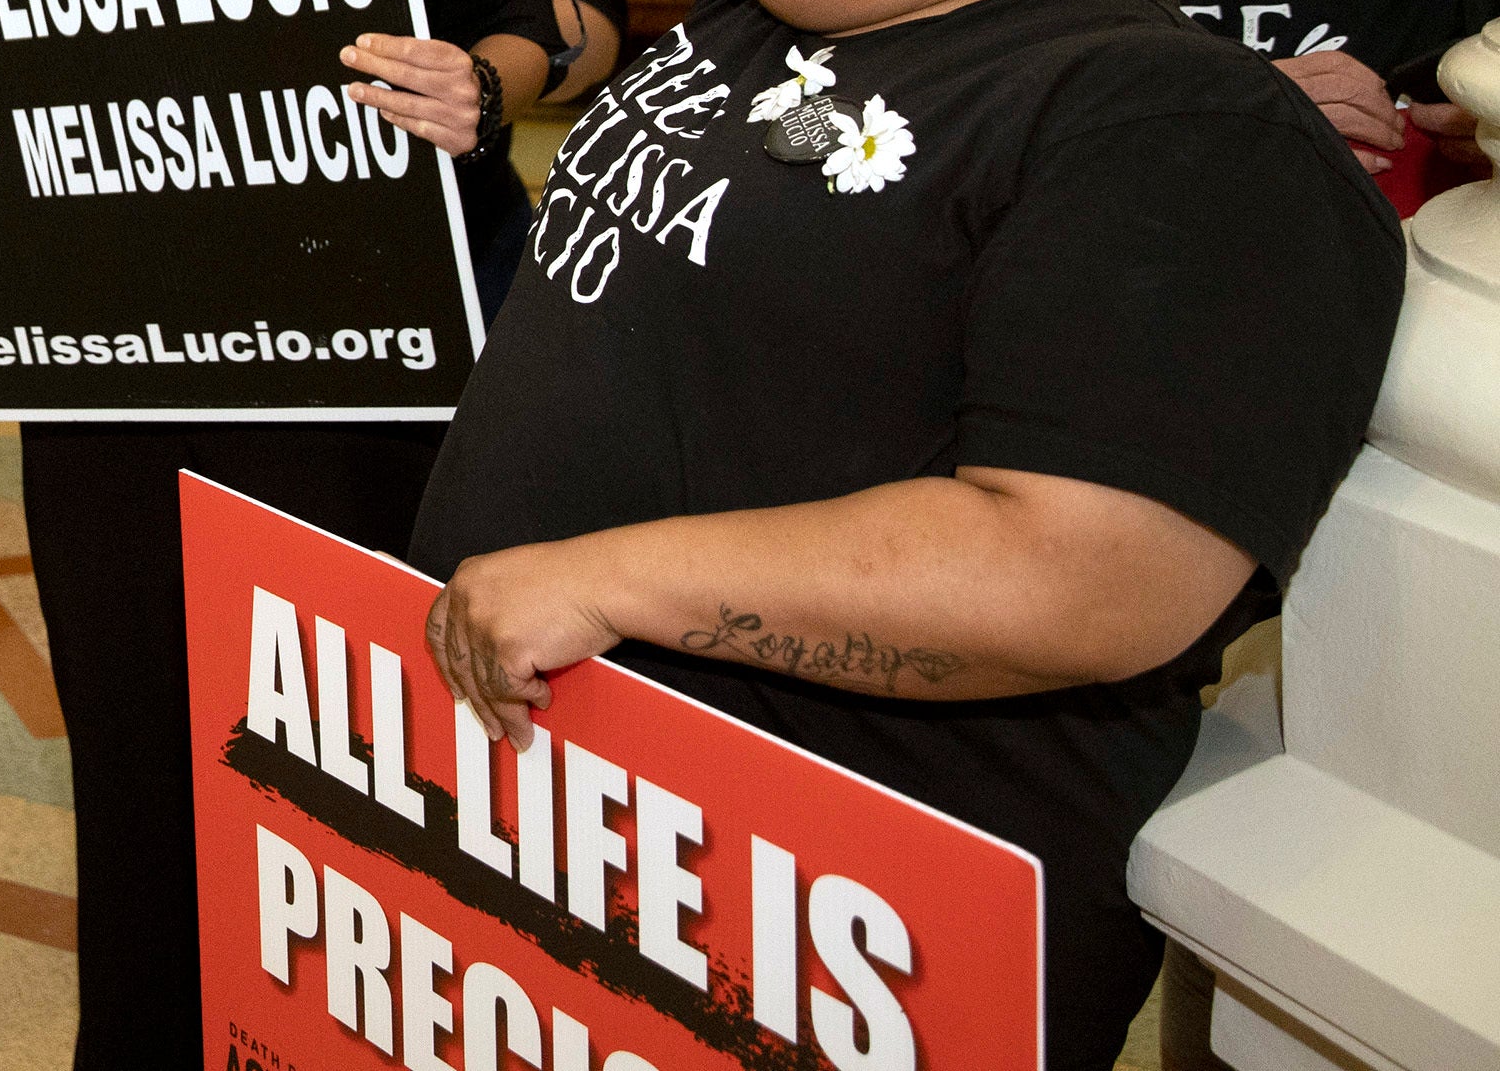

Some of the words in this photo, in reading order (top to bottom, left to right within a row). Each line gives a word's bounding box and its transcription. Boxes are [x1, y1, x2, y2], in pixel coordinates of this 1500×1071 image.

[11, 95, 235, 199] MELISSA
[235, 79, 410, 188] LUCIO
[247, 584, 426, 829] ALL
[454, 698, 709, 992] LIFE
[750, 833, 916, 1071] IS
[229, 1021, 280, 1070] DEATH
